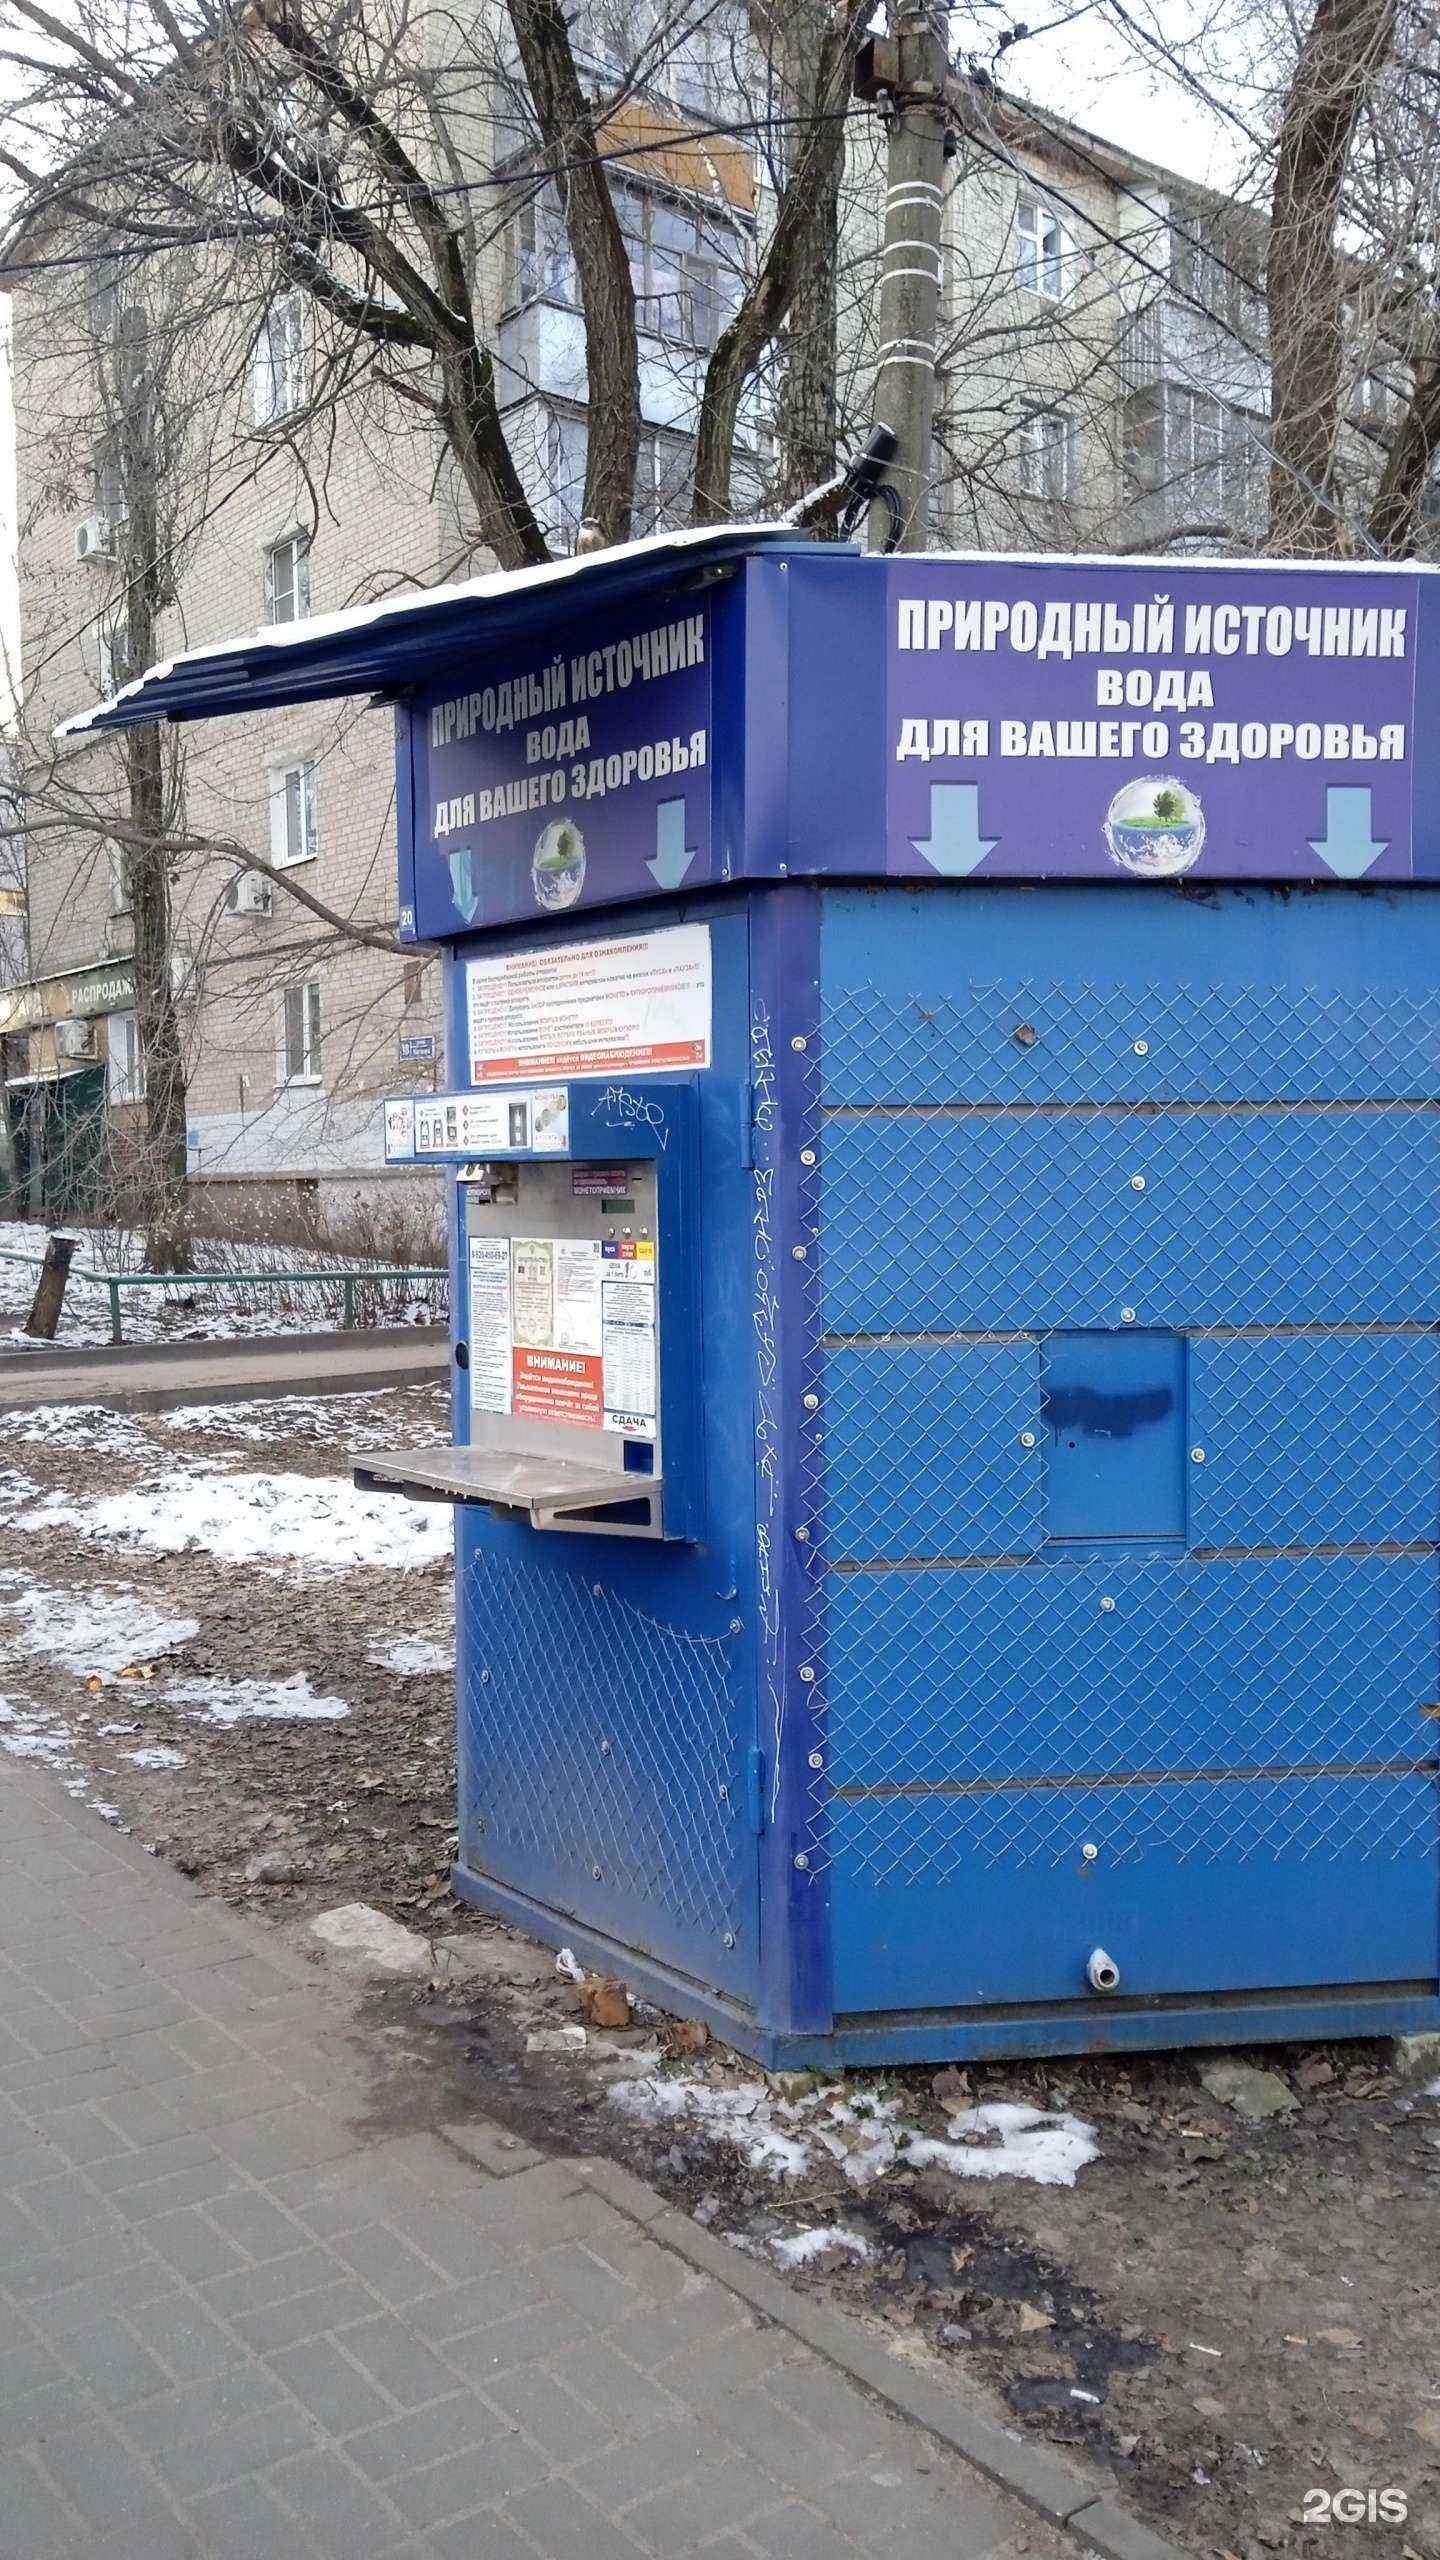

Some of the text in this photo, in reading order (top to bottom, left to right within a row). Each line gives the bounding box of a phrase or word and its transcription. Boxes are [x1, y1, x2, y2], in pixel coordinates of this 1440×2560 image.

[898, 594, 1407, 660] ПРИРОДНЫЙ ИСТОЧНИК
[432, 614, 705, 748] ПРИРОДНЫЙ ИСТОЧНИК
[1097, 669, 1215, 712] ВОДА
[526, 715, 591, 765] ВОДА
[896, 718, 1406, 765] ДЛЯ ВАШЕГО ЗДОРОВЬЯ
[434, 729, 707, 839] ДЛЯ ВАШЕГО ЗДОРОВЬЯ
[527, 1355, 586, 1373] ВНИМАНИЕ!
[612, 1414, 647, 1427] СДАЧА
